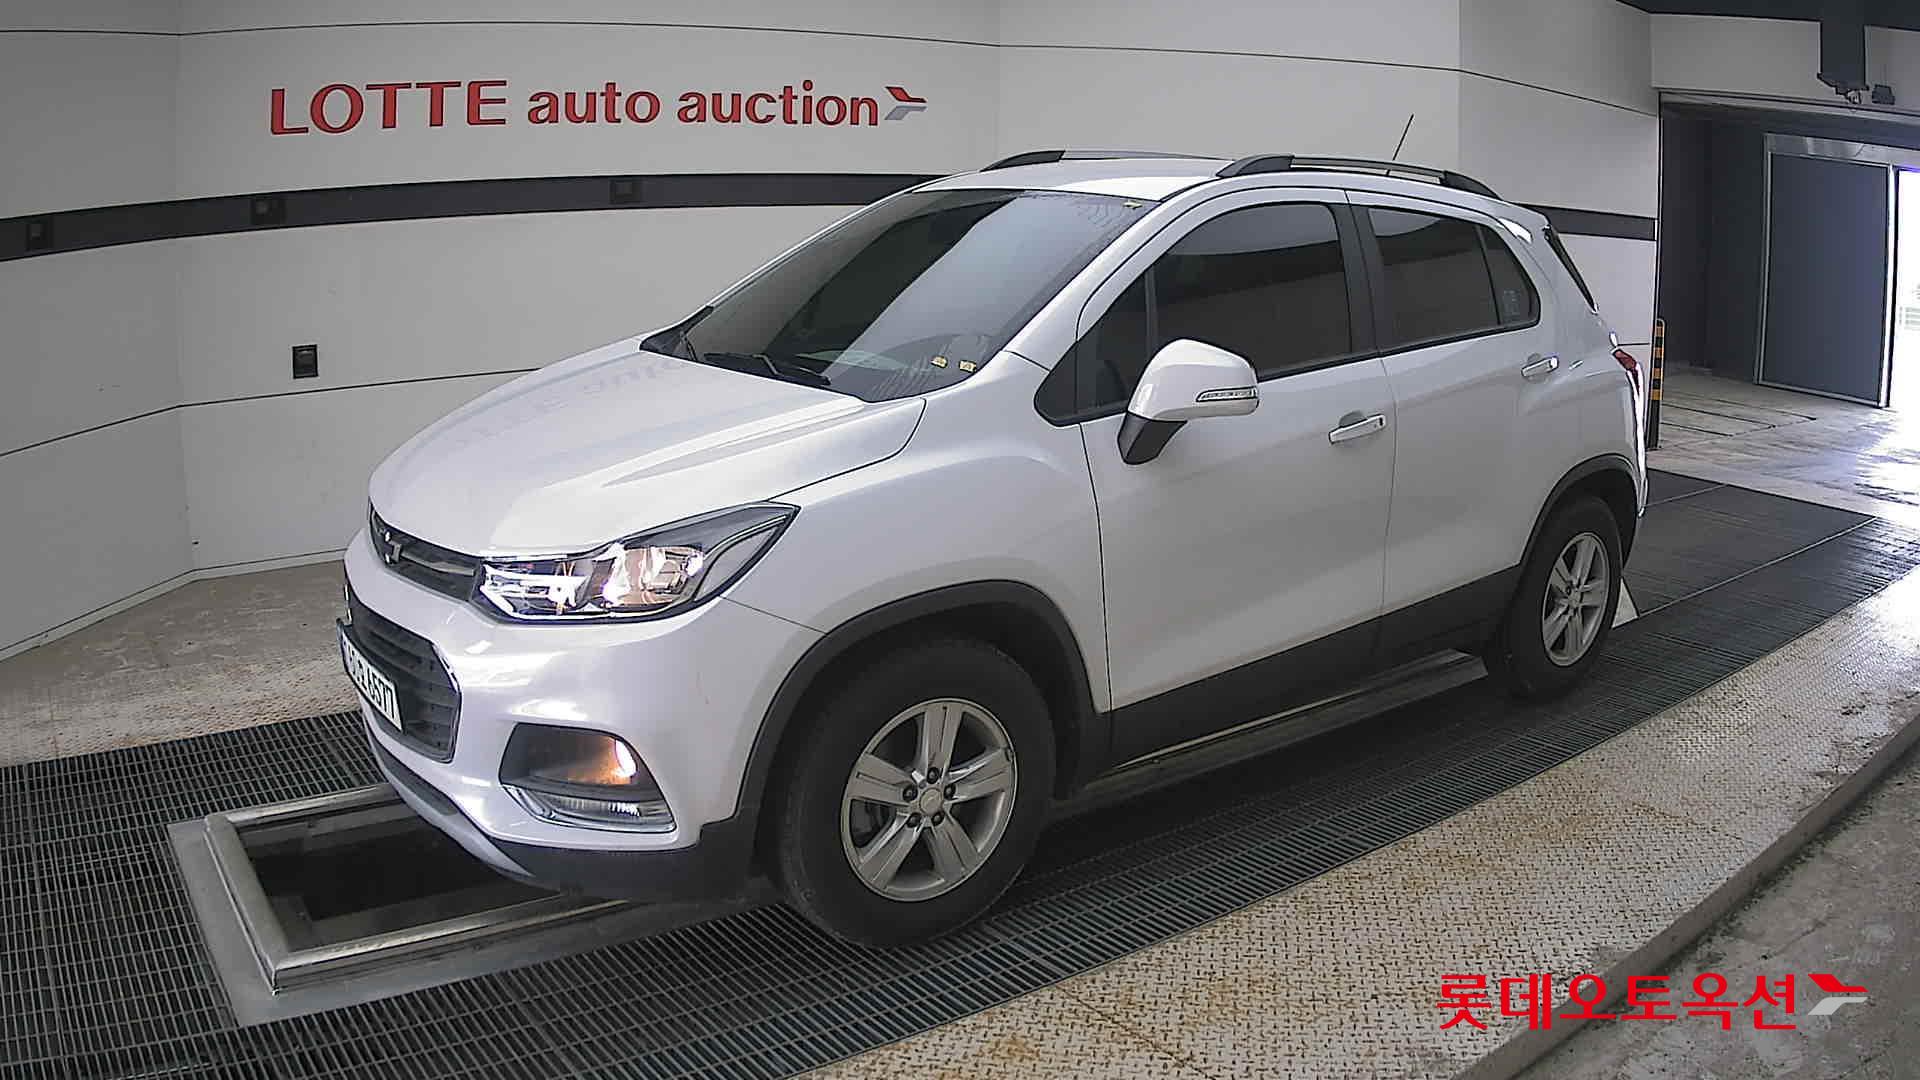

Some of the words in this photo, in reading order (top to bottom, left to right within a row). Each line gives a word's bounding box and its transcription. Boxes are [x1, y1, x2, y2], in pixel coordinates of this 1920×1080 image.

[270, 79, 507, 137] LOTTE
[527, 81, 663, 126] auto
[676, 80, 880, 128] auction
